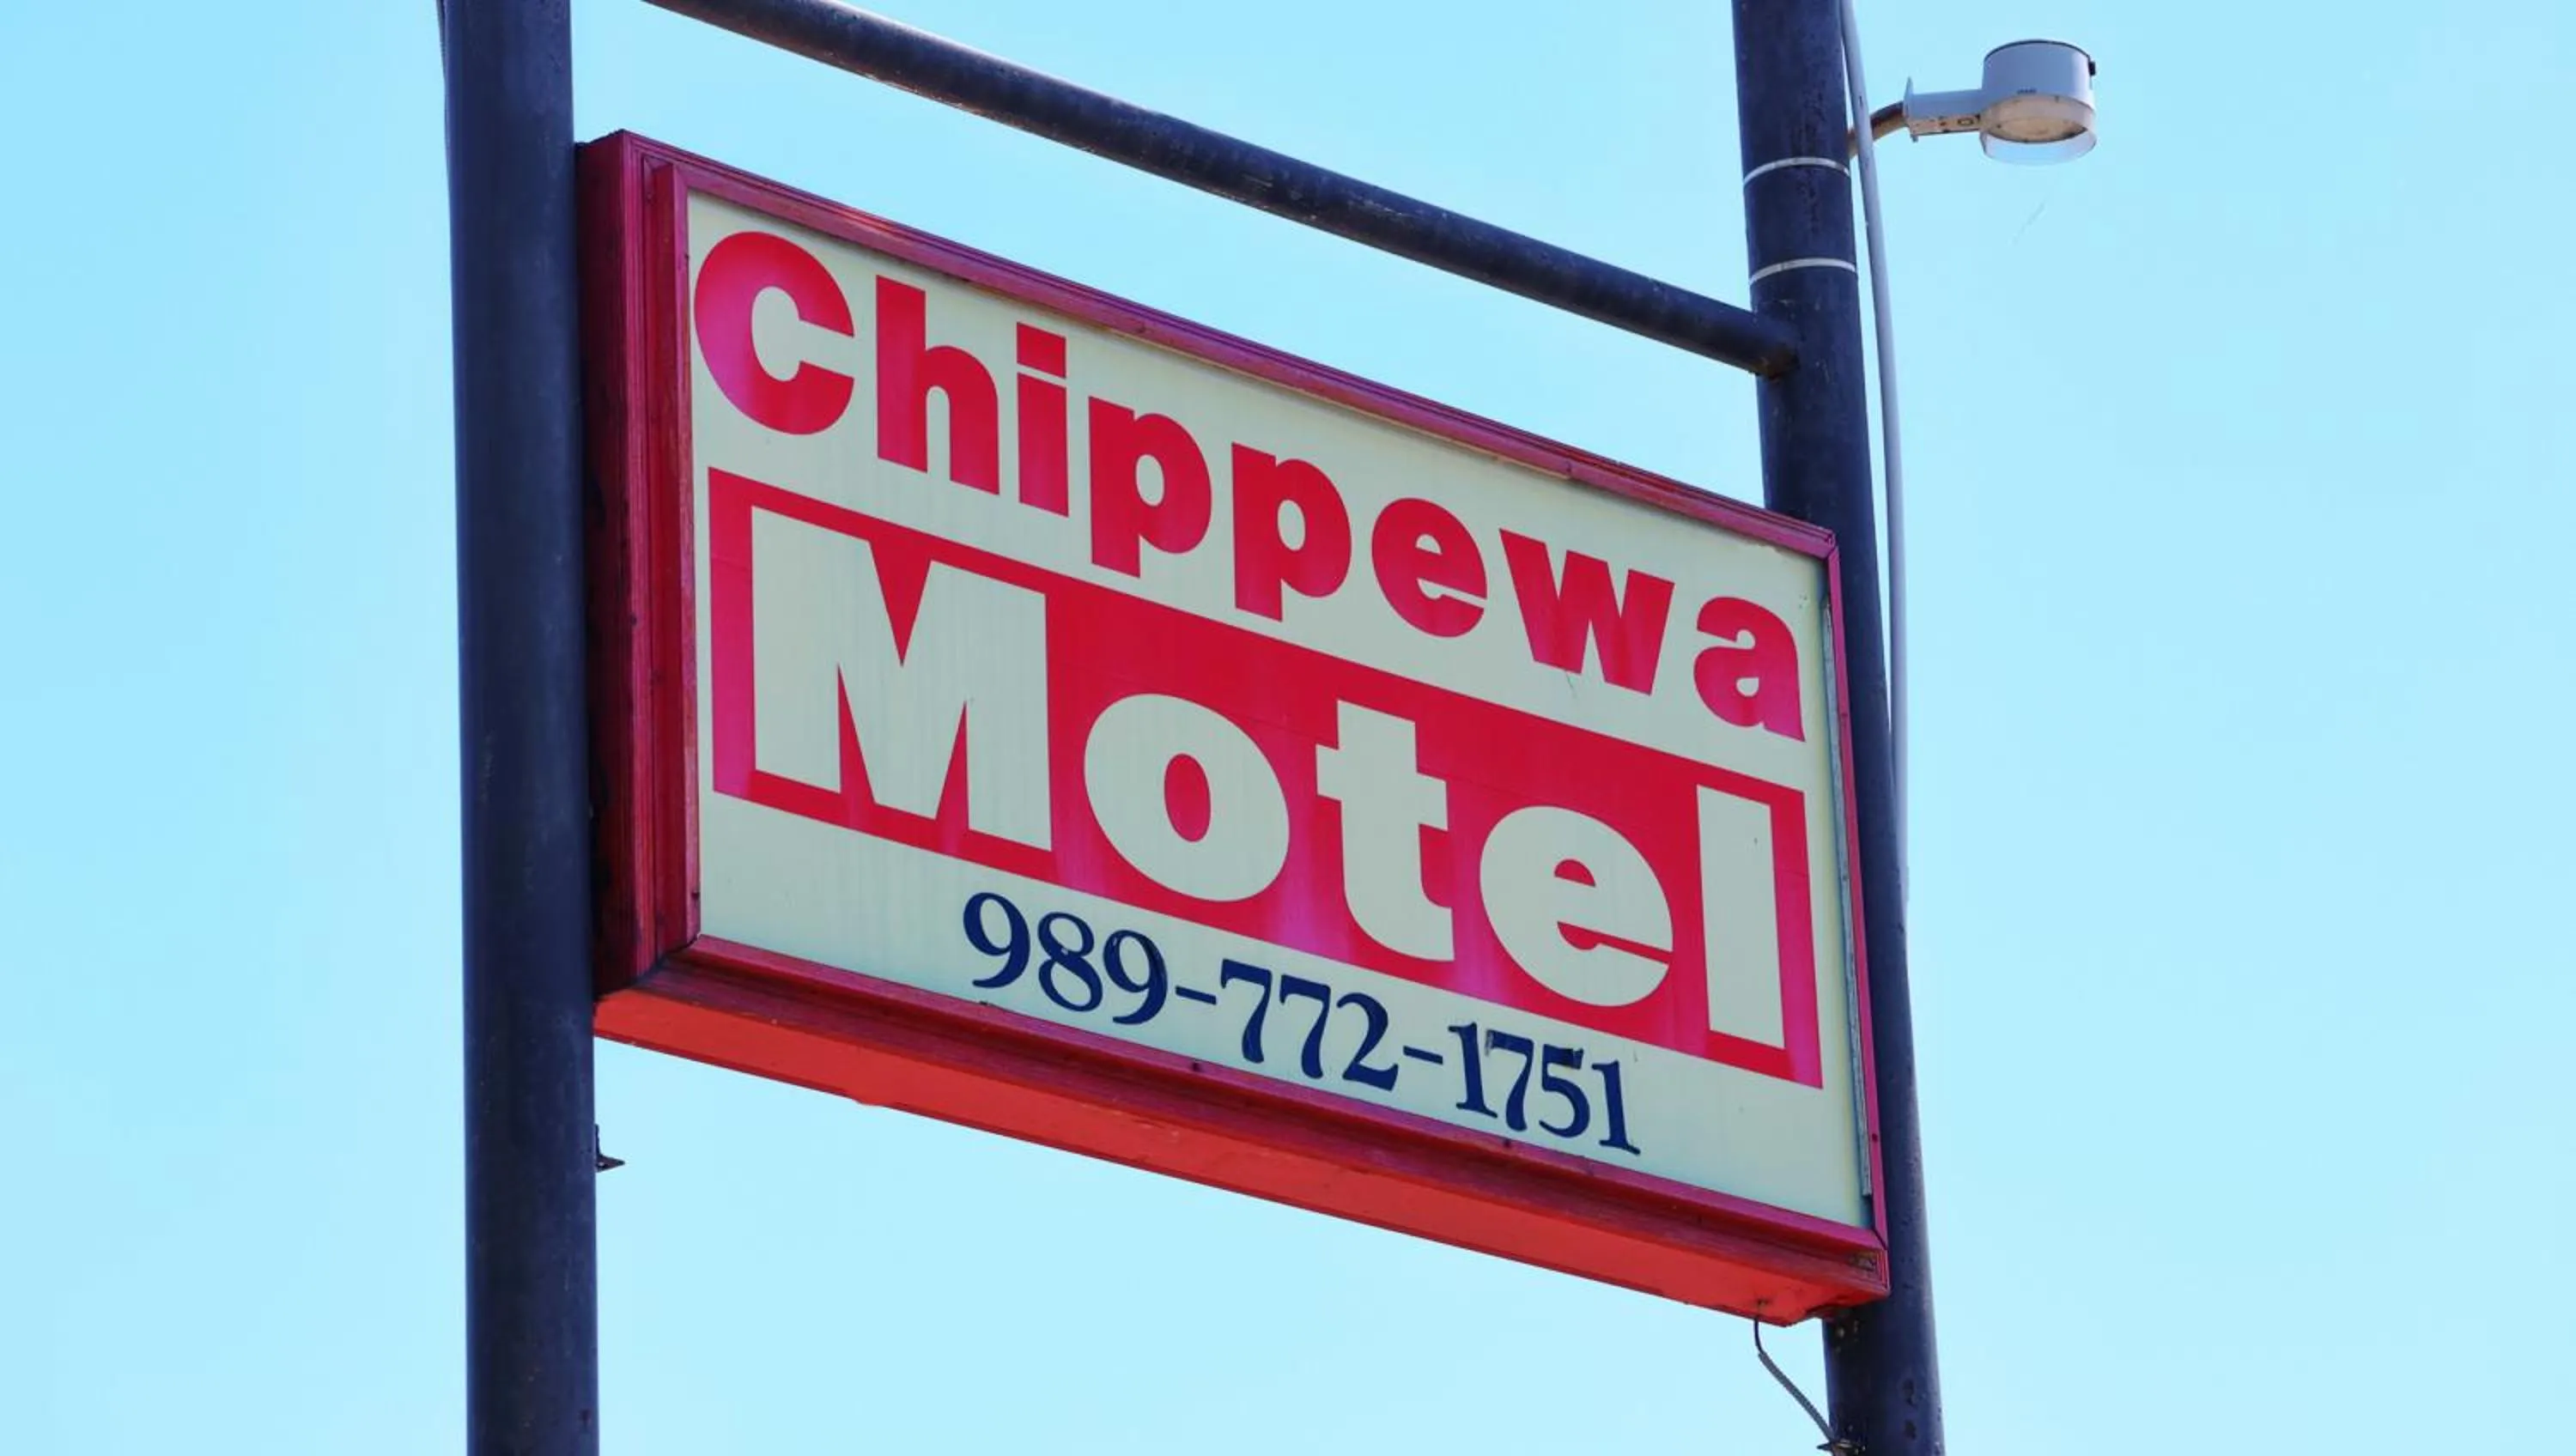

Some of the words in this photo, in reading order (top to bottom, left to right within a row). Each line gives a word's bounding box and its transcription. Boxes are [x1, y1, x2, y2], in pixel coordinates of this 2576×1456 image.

[694, 231, 1806, 743] Chippewa
[750, 505, 1785, 1049] Motel
[963, 891, 1641, 1156] 989-772-1751
